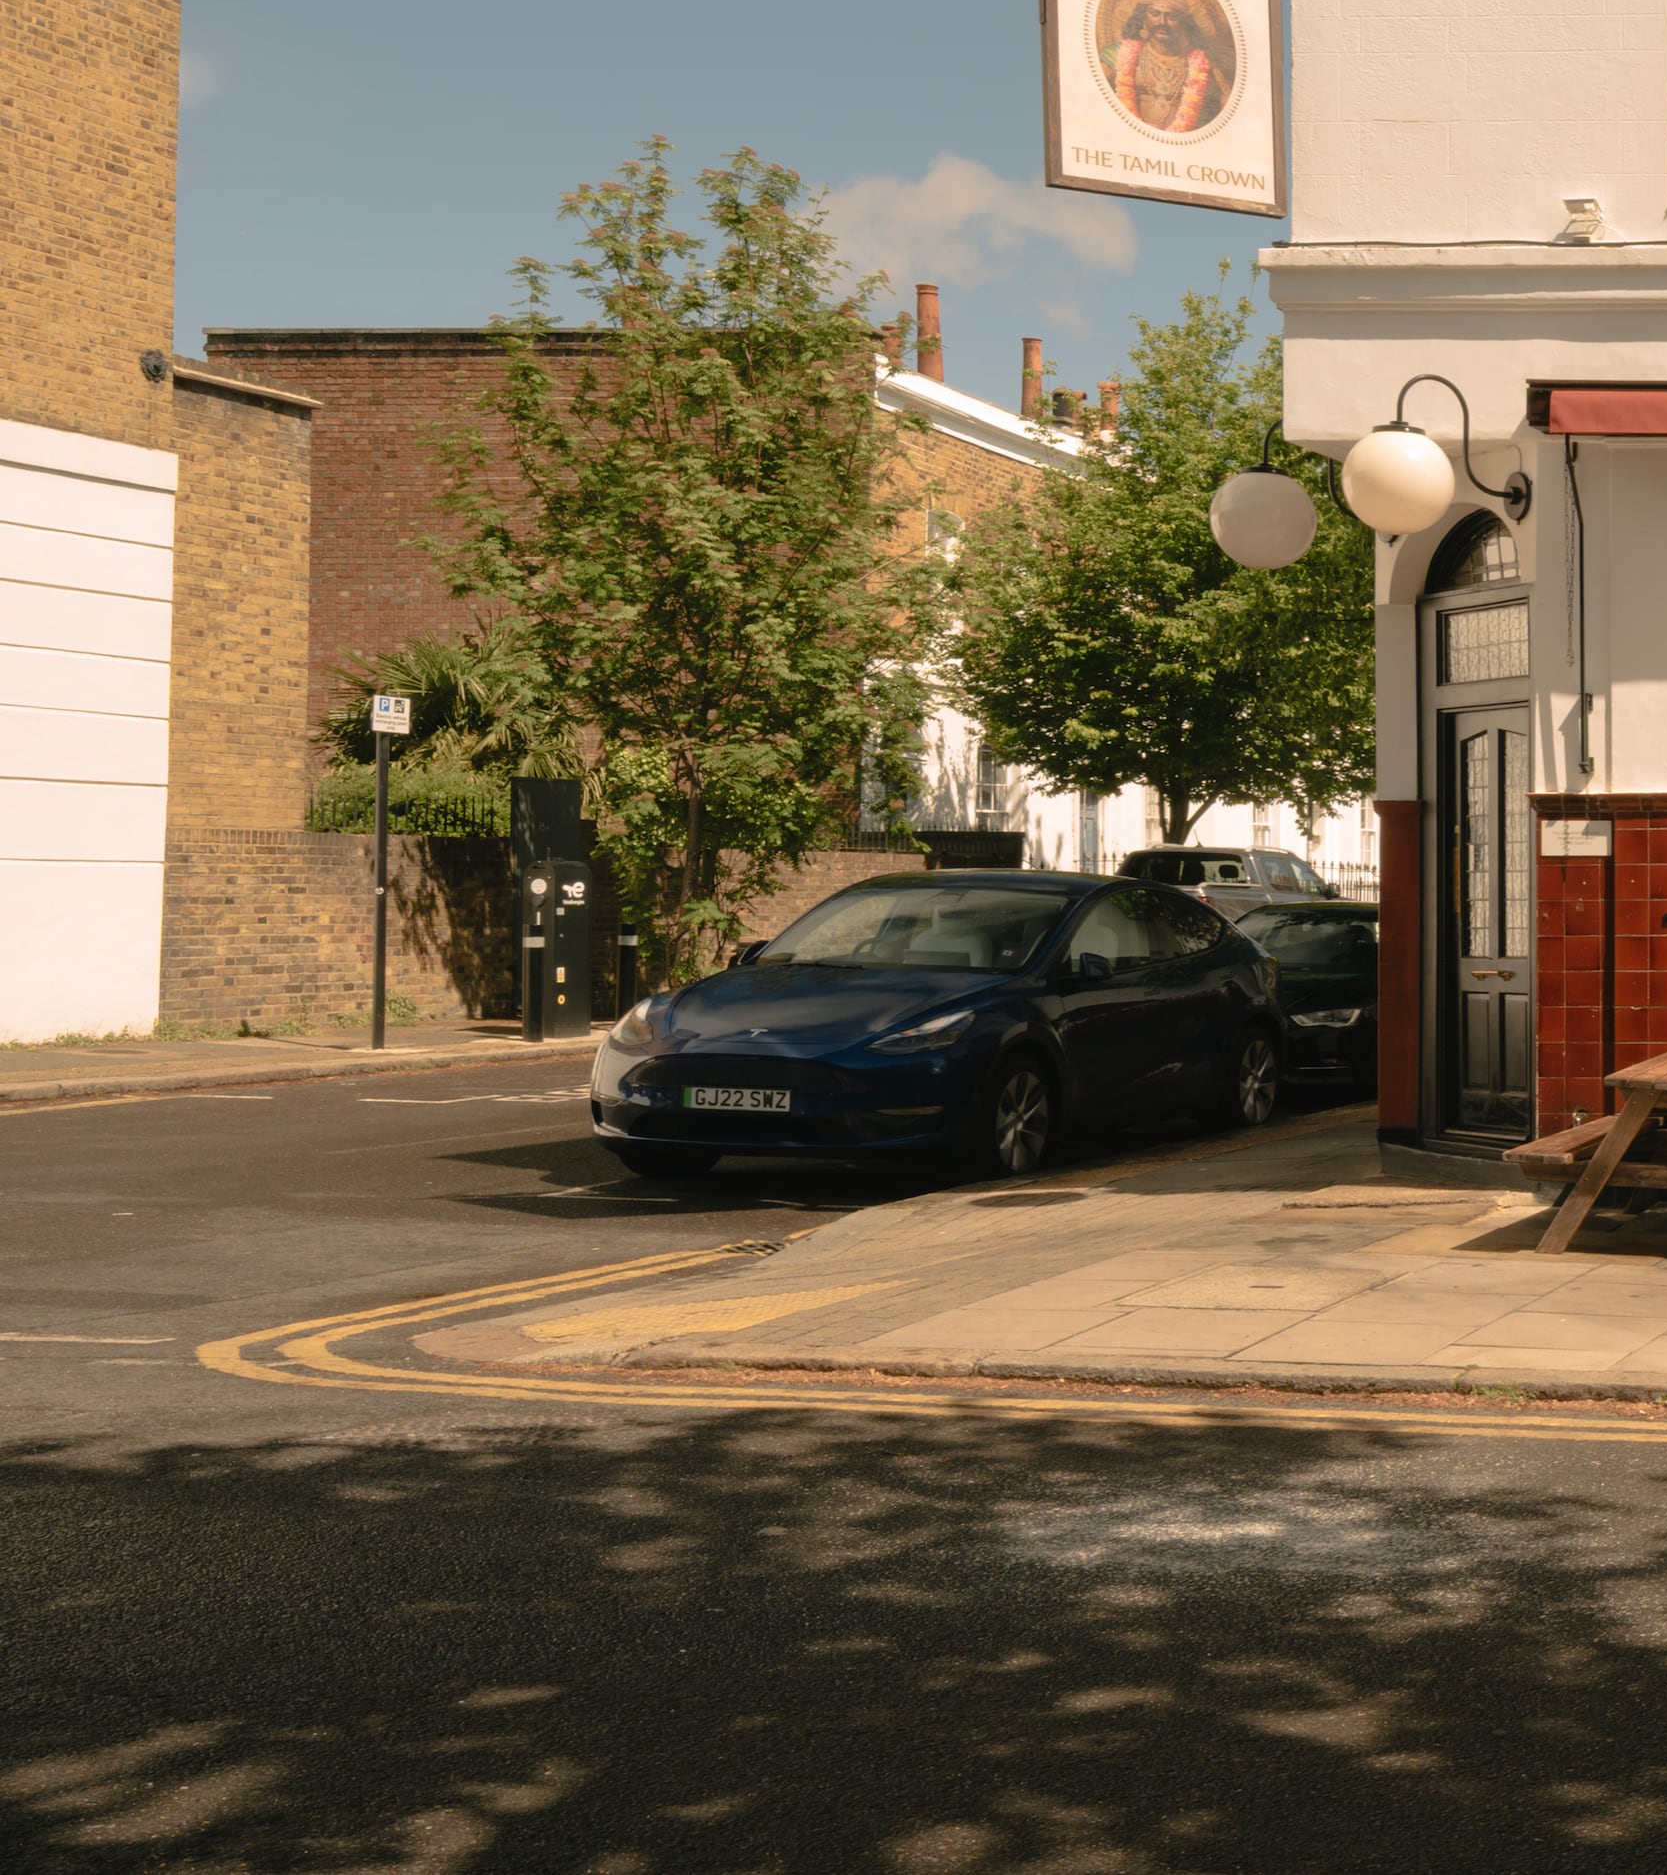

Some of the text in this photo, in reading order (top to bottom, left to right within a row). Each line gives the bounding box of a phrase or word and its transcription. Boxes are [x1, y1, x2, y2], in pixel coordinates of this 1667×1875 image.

[1071, 146, 1265, 191] THE TAMIL CROWN
[695, 1088, 787, 1109] GJ22 SWZ
